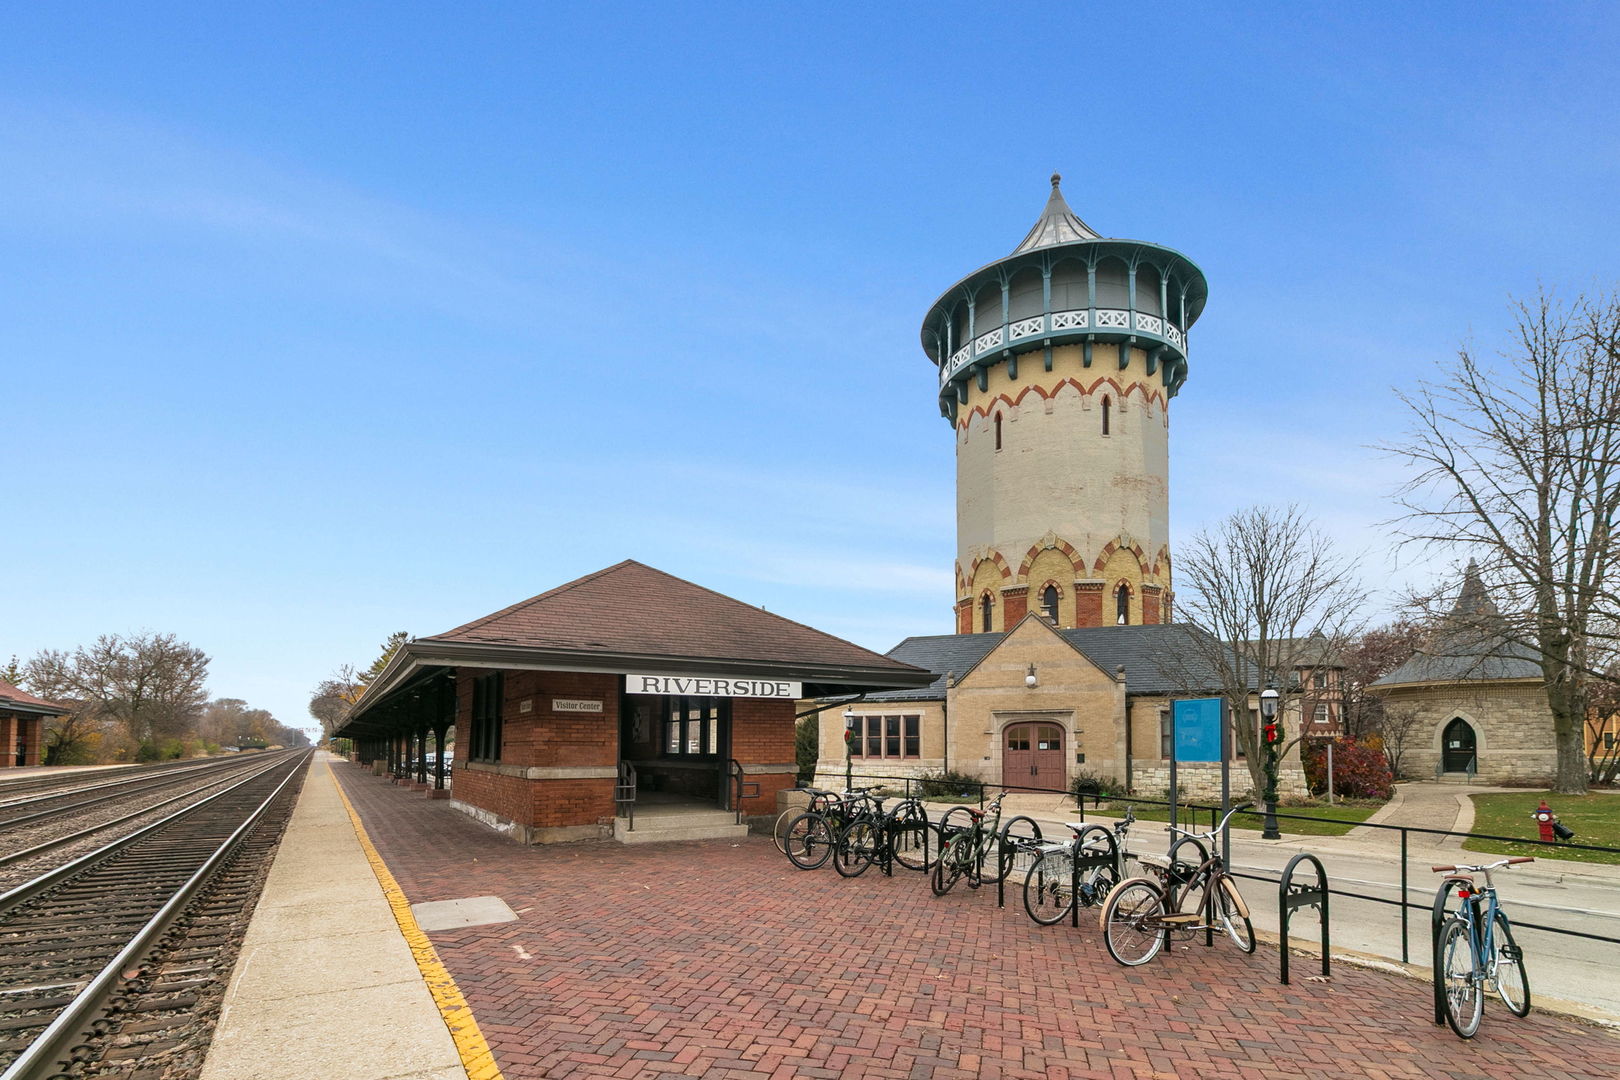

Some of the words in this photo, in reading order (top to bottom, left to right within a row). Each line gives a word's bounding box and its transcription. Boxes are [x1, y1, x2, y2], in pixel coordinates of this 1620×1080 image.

[641, 676, 791, 697] RIVERSIDE
[556, 701, 578, 710] Visitor
[579, 702, 601, 711] Center
